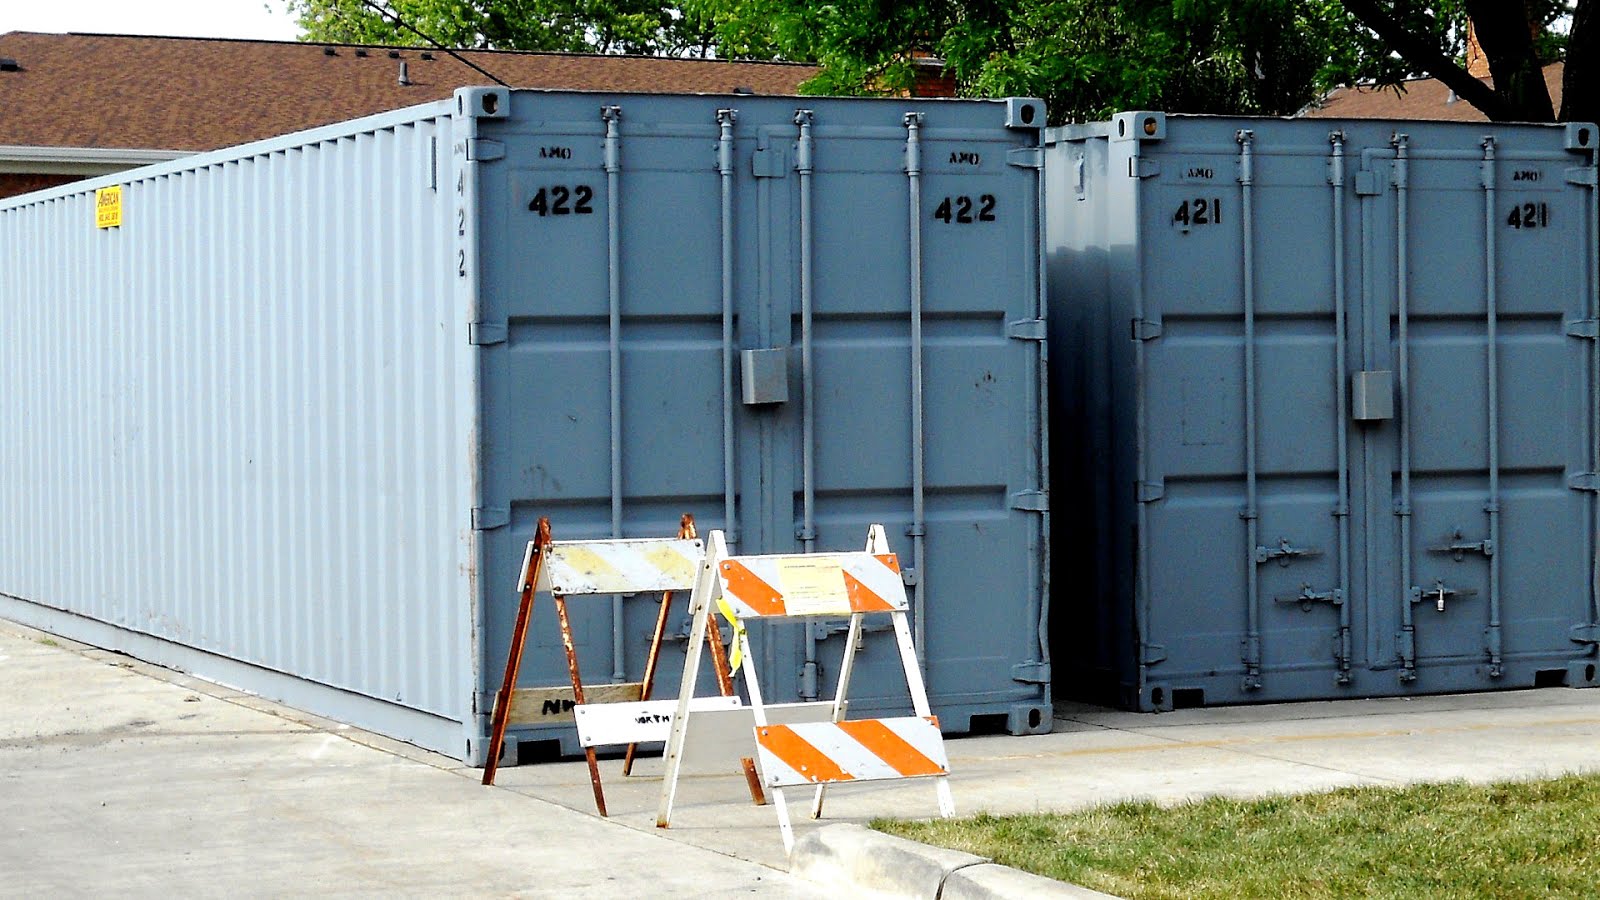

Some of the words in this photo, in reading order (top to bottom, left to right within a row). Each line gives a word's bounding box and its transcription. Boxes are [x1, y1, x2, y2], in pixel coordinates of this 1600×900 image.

[1187, 168, 1213, 179] AMO
[1513, 171, 1538, 182] AMO
[529, 185, 593, 217] 422
[935, 194, 996, 224] 422
[1174, 198, 1221, 226] 421
[1508, 202, 1547, 229] 421
